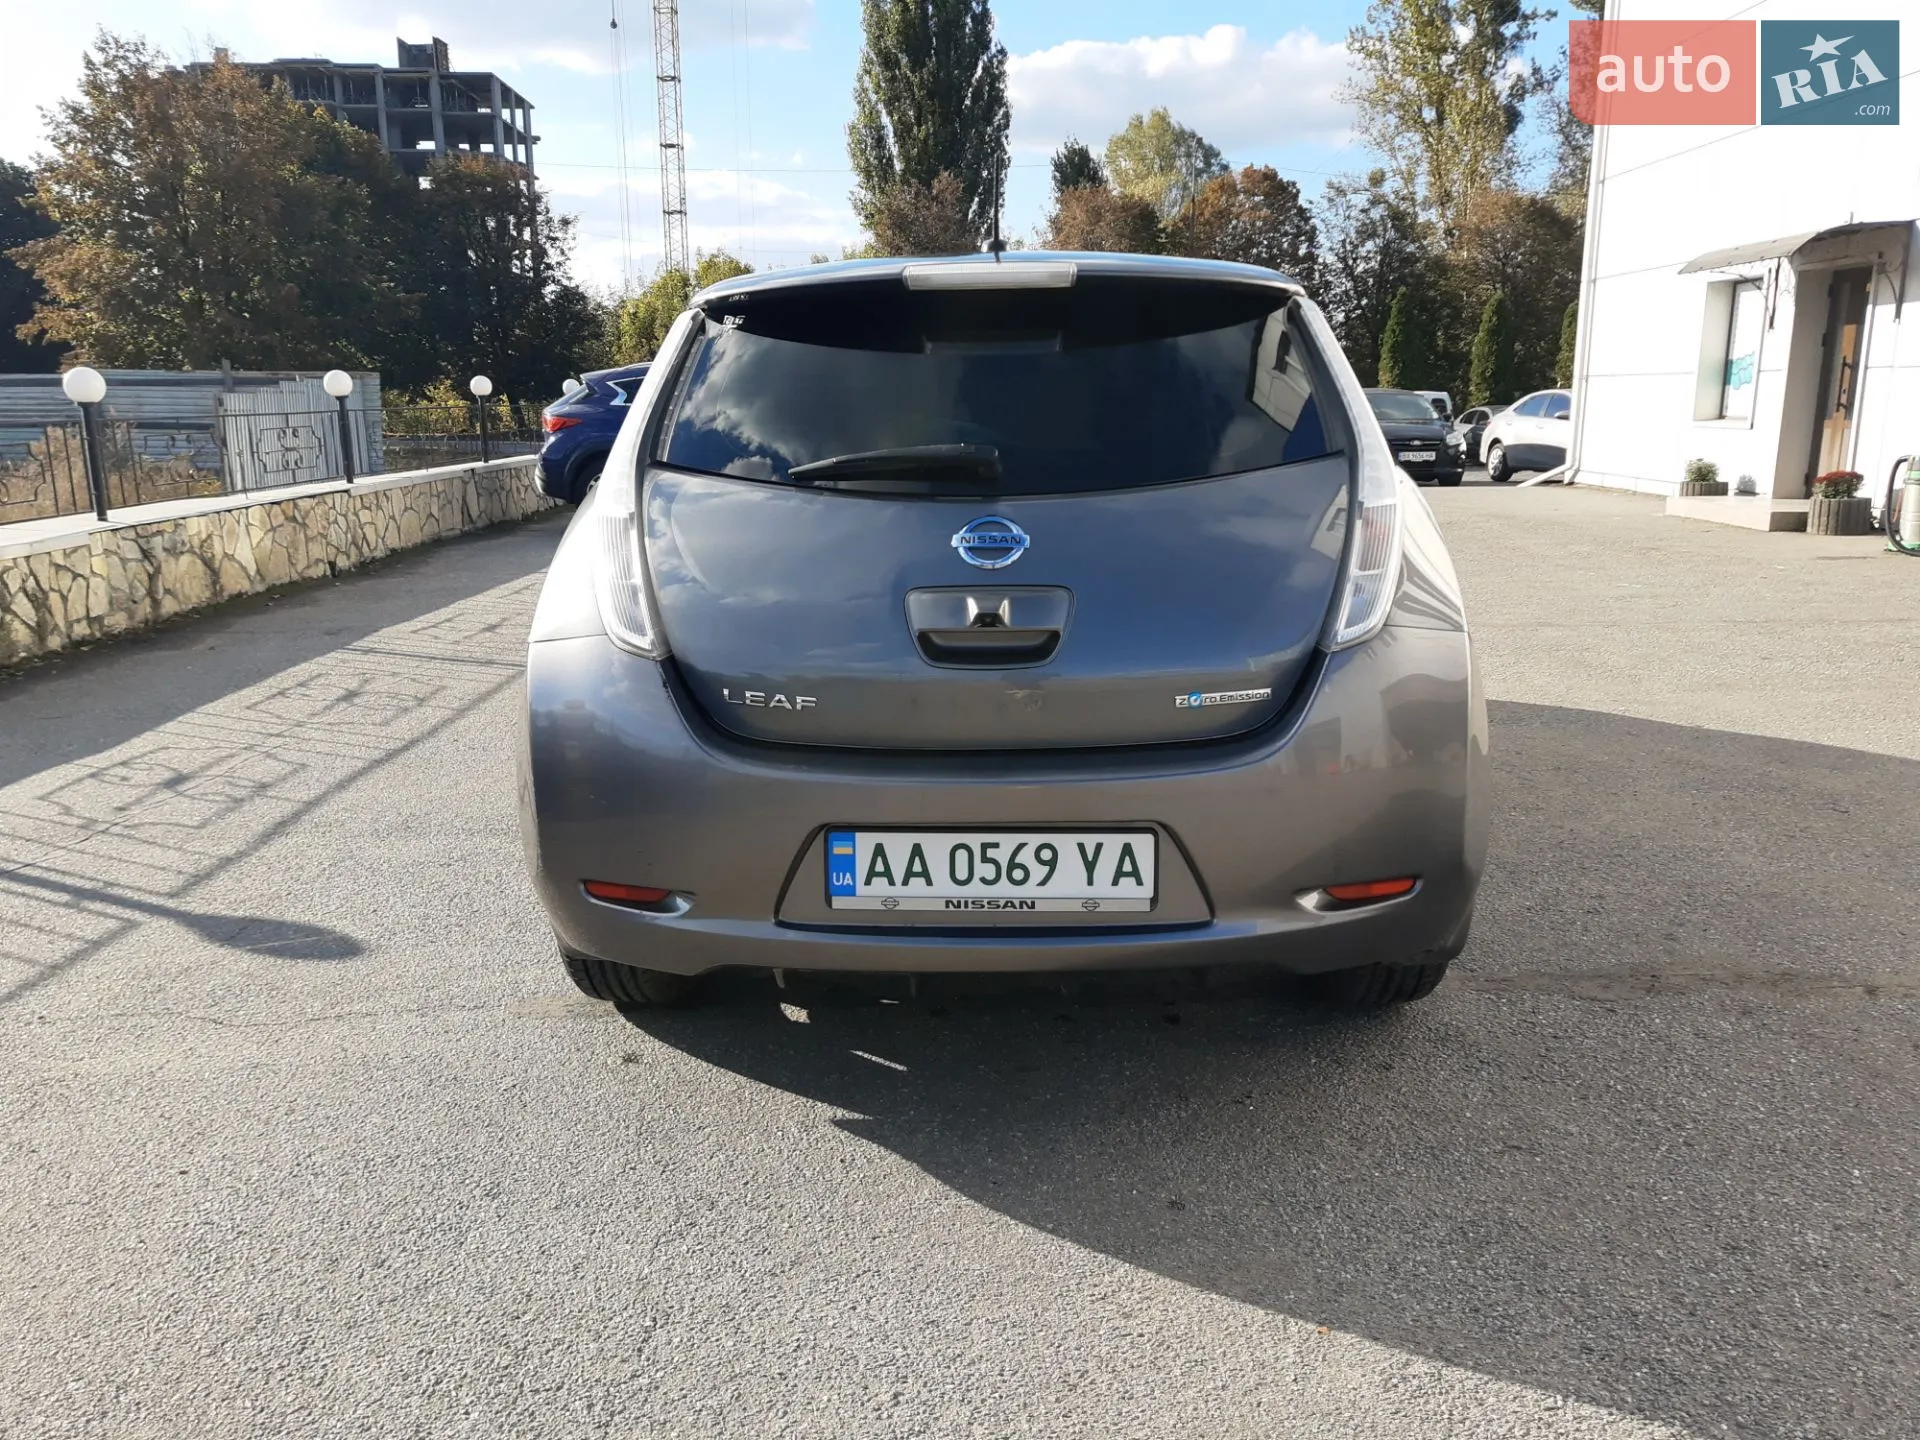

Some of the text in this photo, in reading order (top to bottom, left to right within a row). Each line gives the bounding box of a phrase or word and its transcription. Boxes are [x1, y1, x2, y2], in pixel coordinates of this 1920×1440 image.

[960, 535, 1021, 545] NISSAN
[722, 688, 818, 711] LEAF
[863, 842, 1144, 887] AA 0569 YA
[832, 871, 854, 886] UA
[944, 899, 1036, 910] NISSAN
